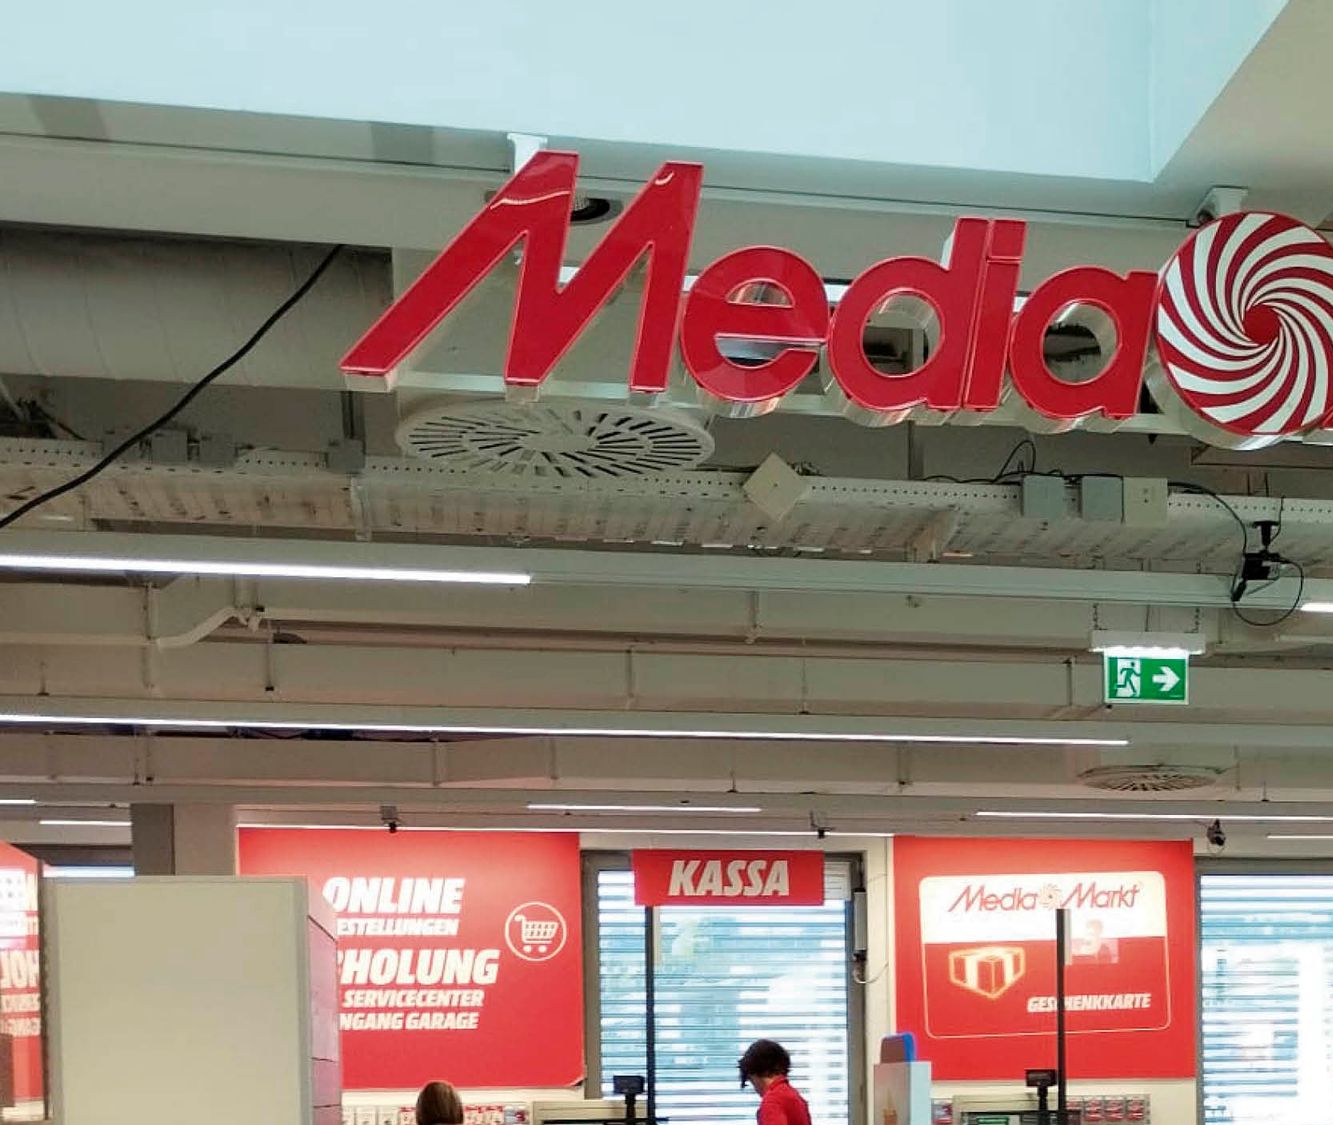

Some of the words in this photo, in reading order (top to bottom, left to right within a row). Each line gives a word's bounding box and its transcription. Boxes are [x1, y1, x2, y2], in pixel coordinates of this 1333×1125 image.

[340, 150, 1162, 419] Media
[668, 861, 790, 897] KASSA
[323, 877, 465, 914] ONLINE
[948, 884, 1038, 912] Media
[1062, 881, 1139, 908] Markt
[337, 918, 460, 936] ESTELLUNGEN
[338, 949, 500, 985] HOLUNG
[342, 989, 485, 1008] SERVICECENTER
[1026, 993, 1153, 1013] GESCHENKKARTE
[339, 1012, 404, 1030] NGANG
[405, 1012, 480, 1029] GARAGE
